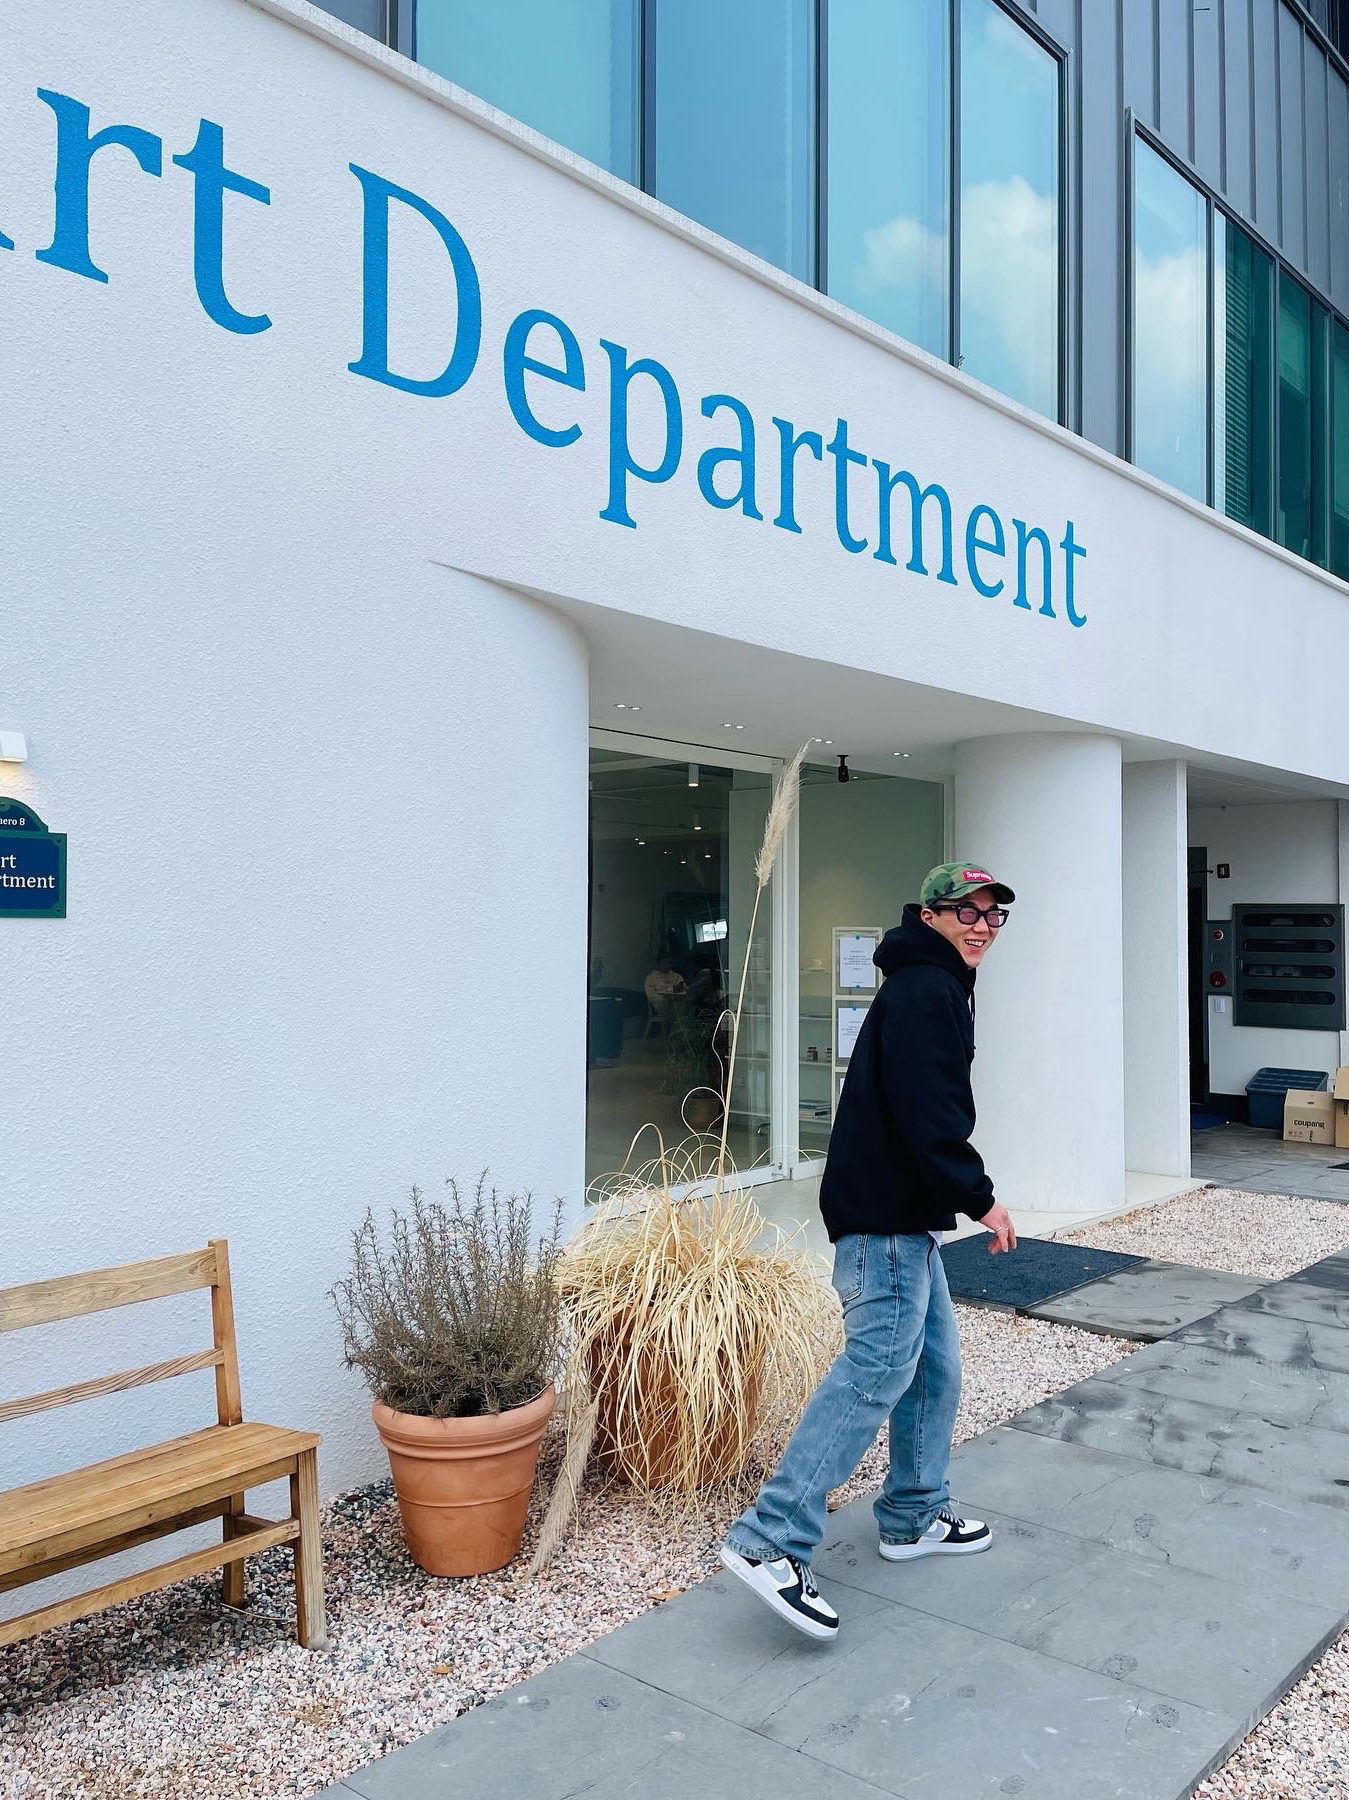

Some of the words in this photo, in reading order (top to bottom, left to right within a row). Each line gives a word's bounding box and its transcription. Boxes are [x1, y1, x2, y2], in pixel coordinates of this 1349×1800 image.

[0, 87, 272, 335] rt
[347, 163, 1087, 628] Department
[19, 817, 26, 826] 8
[0, 854, 17, 869] rt
[1293, 1119, 1325, 1130] coupang
